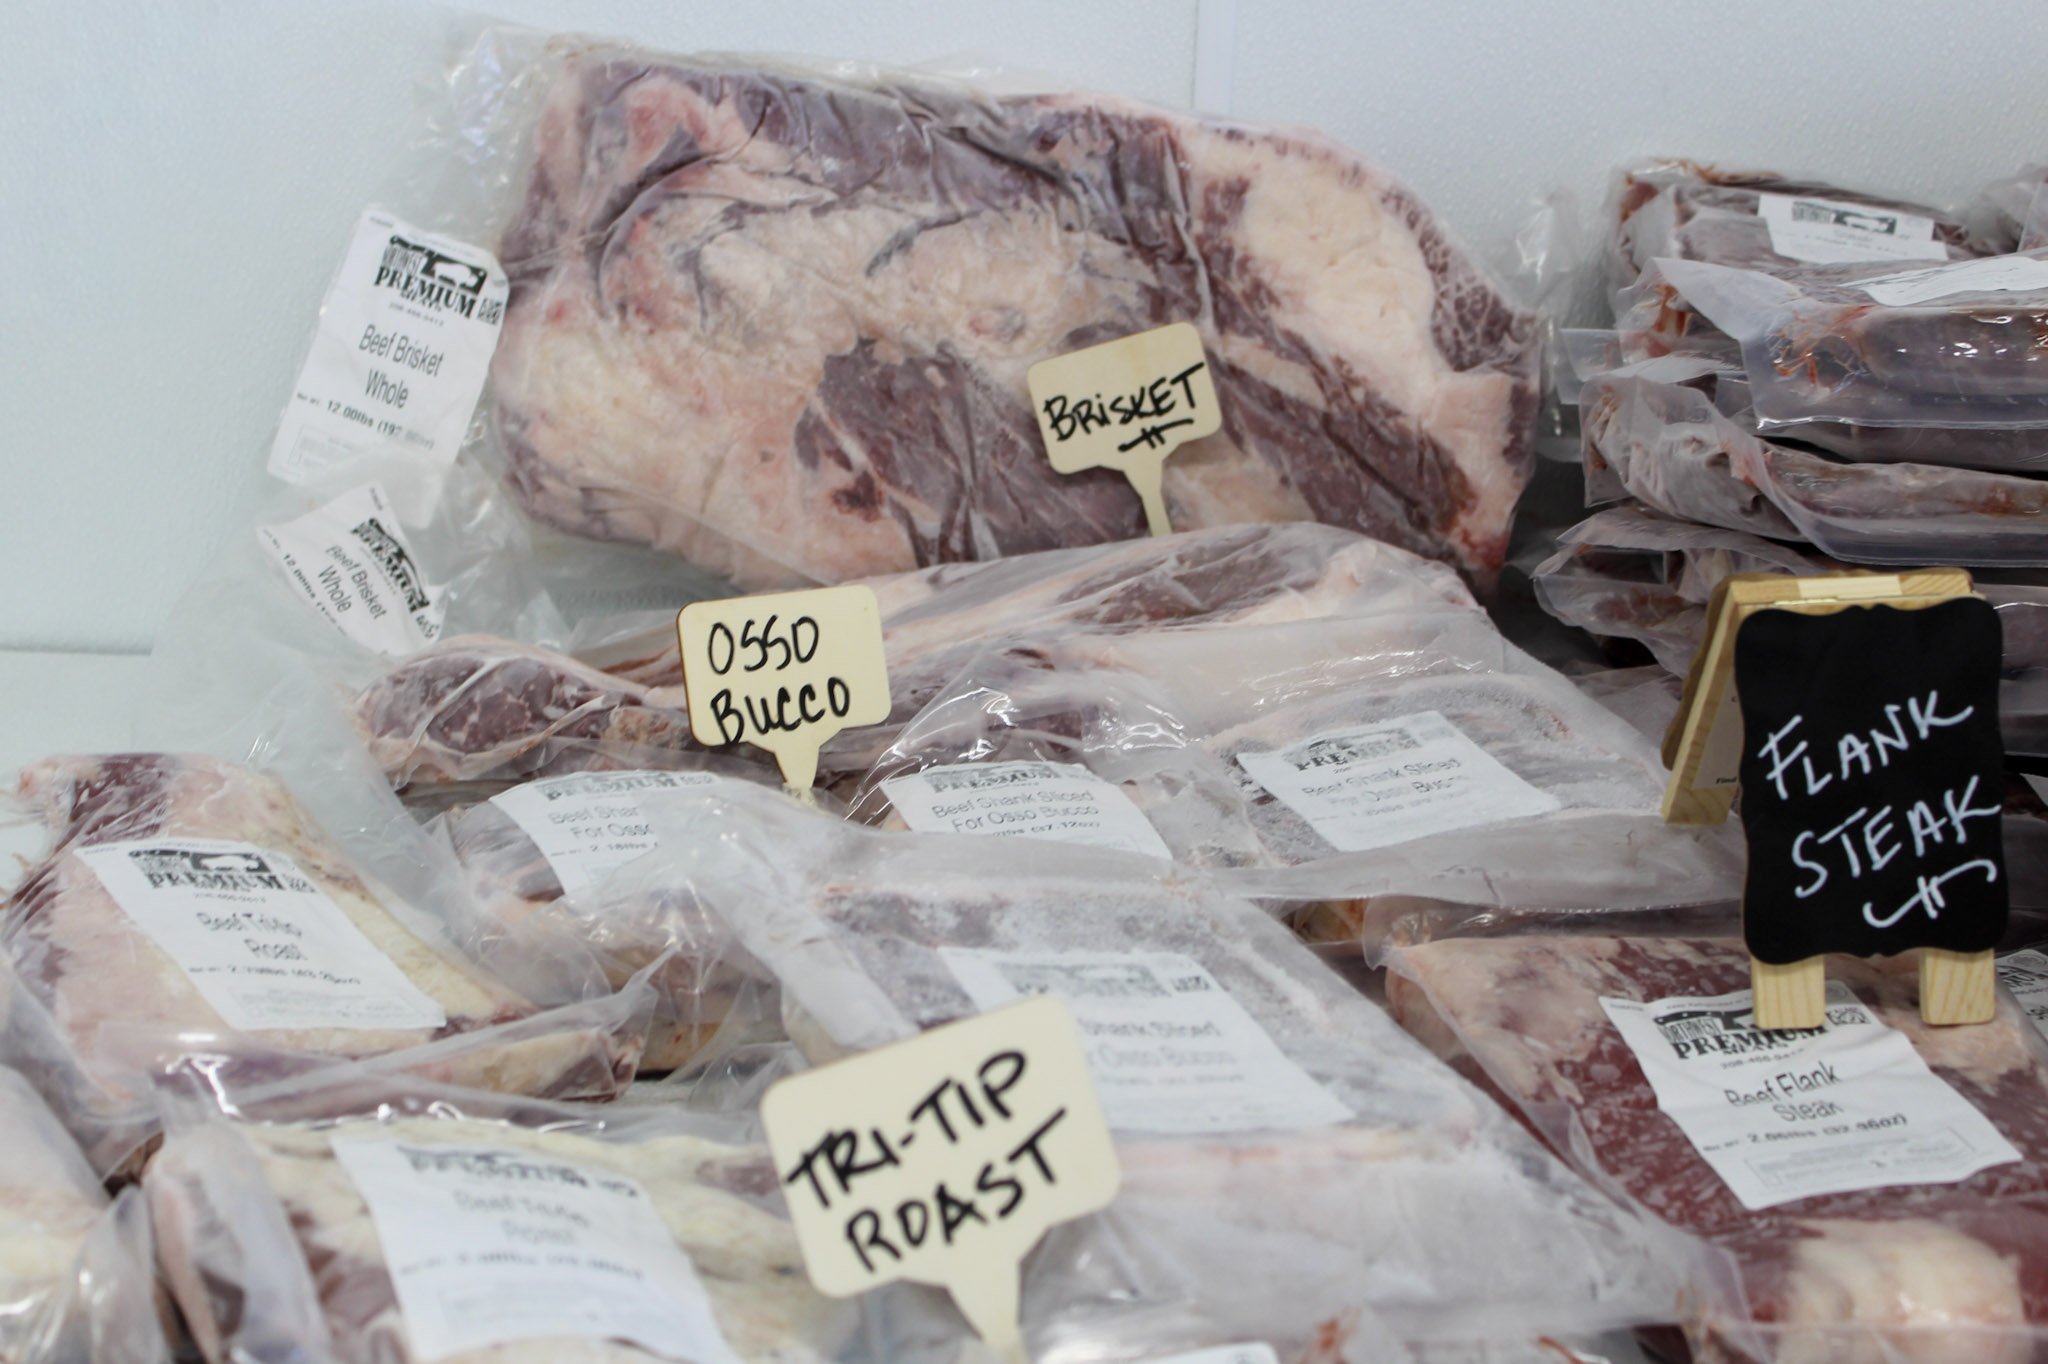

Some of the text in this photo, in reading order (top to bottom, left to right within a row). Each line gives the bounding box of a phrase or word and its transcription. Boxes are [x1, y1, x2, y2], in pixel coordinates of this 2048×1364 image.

[374, 266, 478, 319] PREMIUM
[358, 324, 444, 377] Beef Brisket
[365, 367, 409, 409] Whole
[317, 564, 352, 614] Whole
[325, 545, 357, 572] Beef
[351, 569, 387, 620] Brisket
[708, 614, 820, 676] OSSO
[1757, 689, 1975, 801] FLANK
[931, 799, 977, 819] Beef
[976, 793, 1034, 810] Shank
[951, 816, 984, 833] For
[987, 809, 1037, 825] Osso
[1791, 774, 2002, 899] STEAK
[1670, 1026, 1829, 1060] PREMIUM
[1723, 1061, 1843, 1107] Beef Flank
[1772, 1099, 1845, 1122] Steak
[786, 1050, 1027, 1210] TRI-TIP
[845, 1105, 1068, 1275] ROAST
